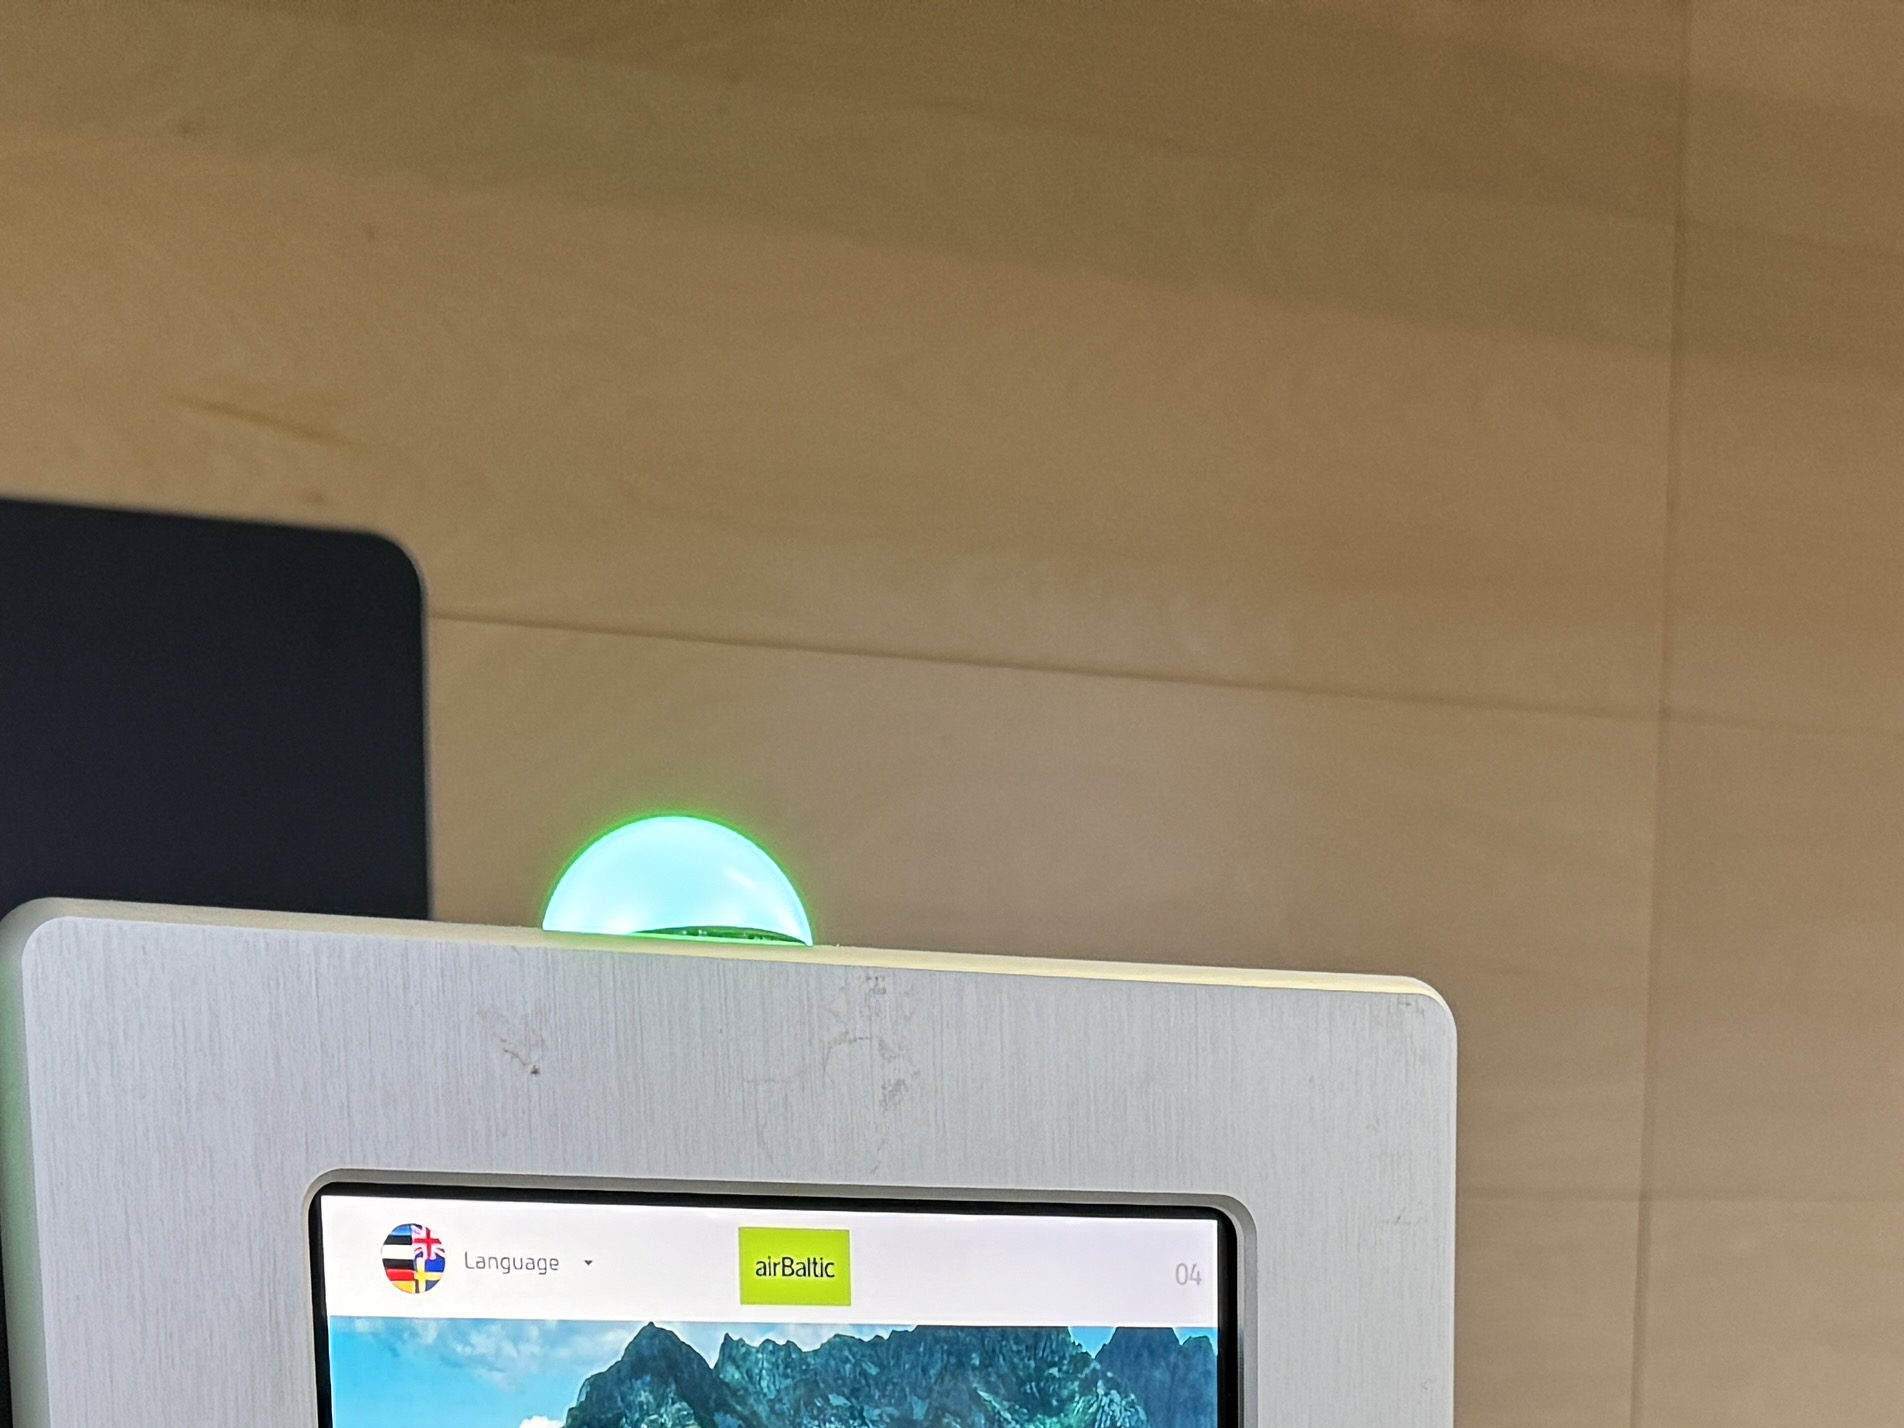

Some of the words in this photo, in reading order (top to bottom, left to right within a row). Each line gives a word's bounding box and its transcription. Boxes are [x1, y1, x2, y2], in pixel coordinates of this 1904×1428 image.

[464, 1251, 560, 1276] Language
[754, 1255, 836, 1280] airBaltic
[1174, 1262, 1203, 1286] 04
